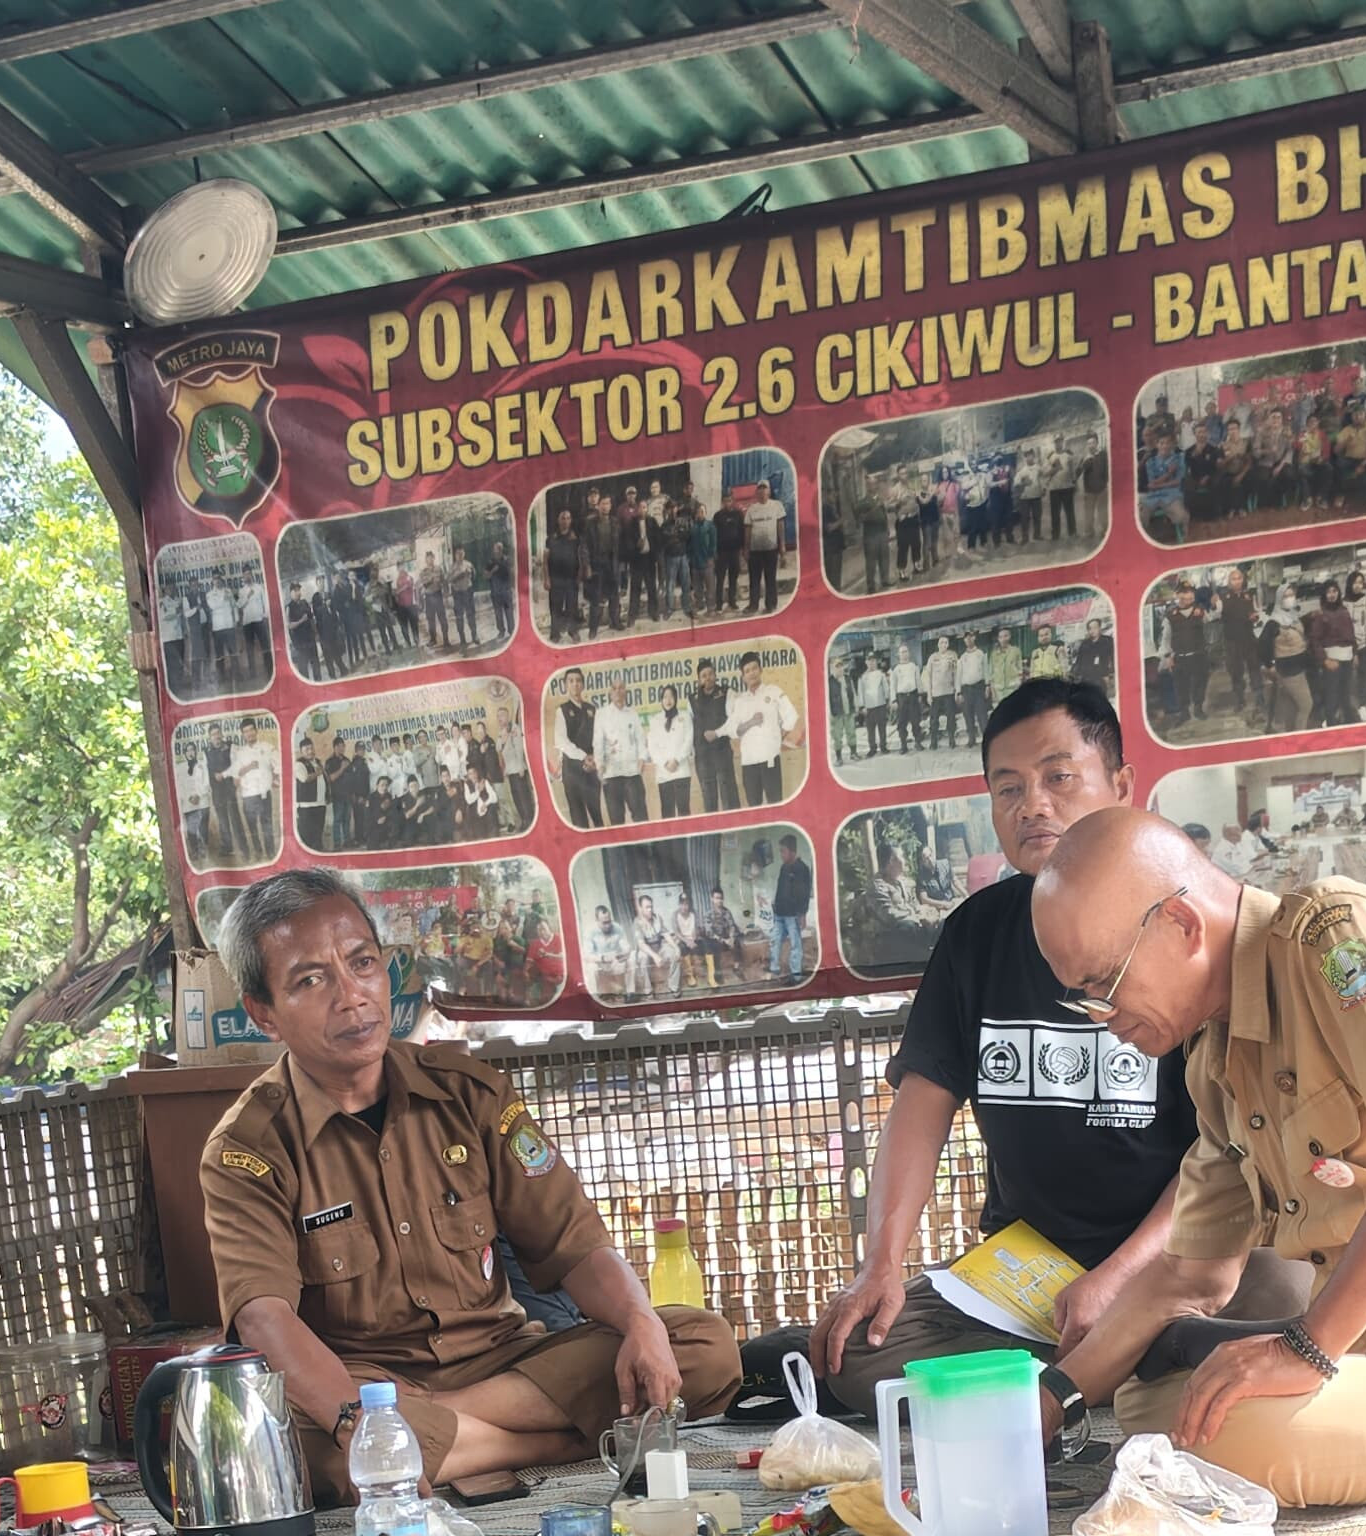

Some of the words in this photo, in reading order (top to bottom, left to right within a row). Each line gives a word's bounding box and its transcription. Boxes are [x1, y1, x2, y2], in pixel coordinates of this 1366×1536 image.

[368, 151, 1235, 392] POKDARKAMTIBMAS
[166, 343, 223, 373] METRO
[227, 340, 266, 358] JAYA
[345, 364, 683, 488] SUBSEKTOR
[701, 346, 797, 426] 2.6
[815, 292, 1089, 405] CIKIWUL
[1117, 1104, 1157, 1115] TARUNA
[1086, 1117, 1128, 1128] FOOTLL
[315, 1209, 345, 1226] SUGENG
